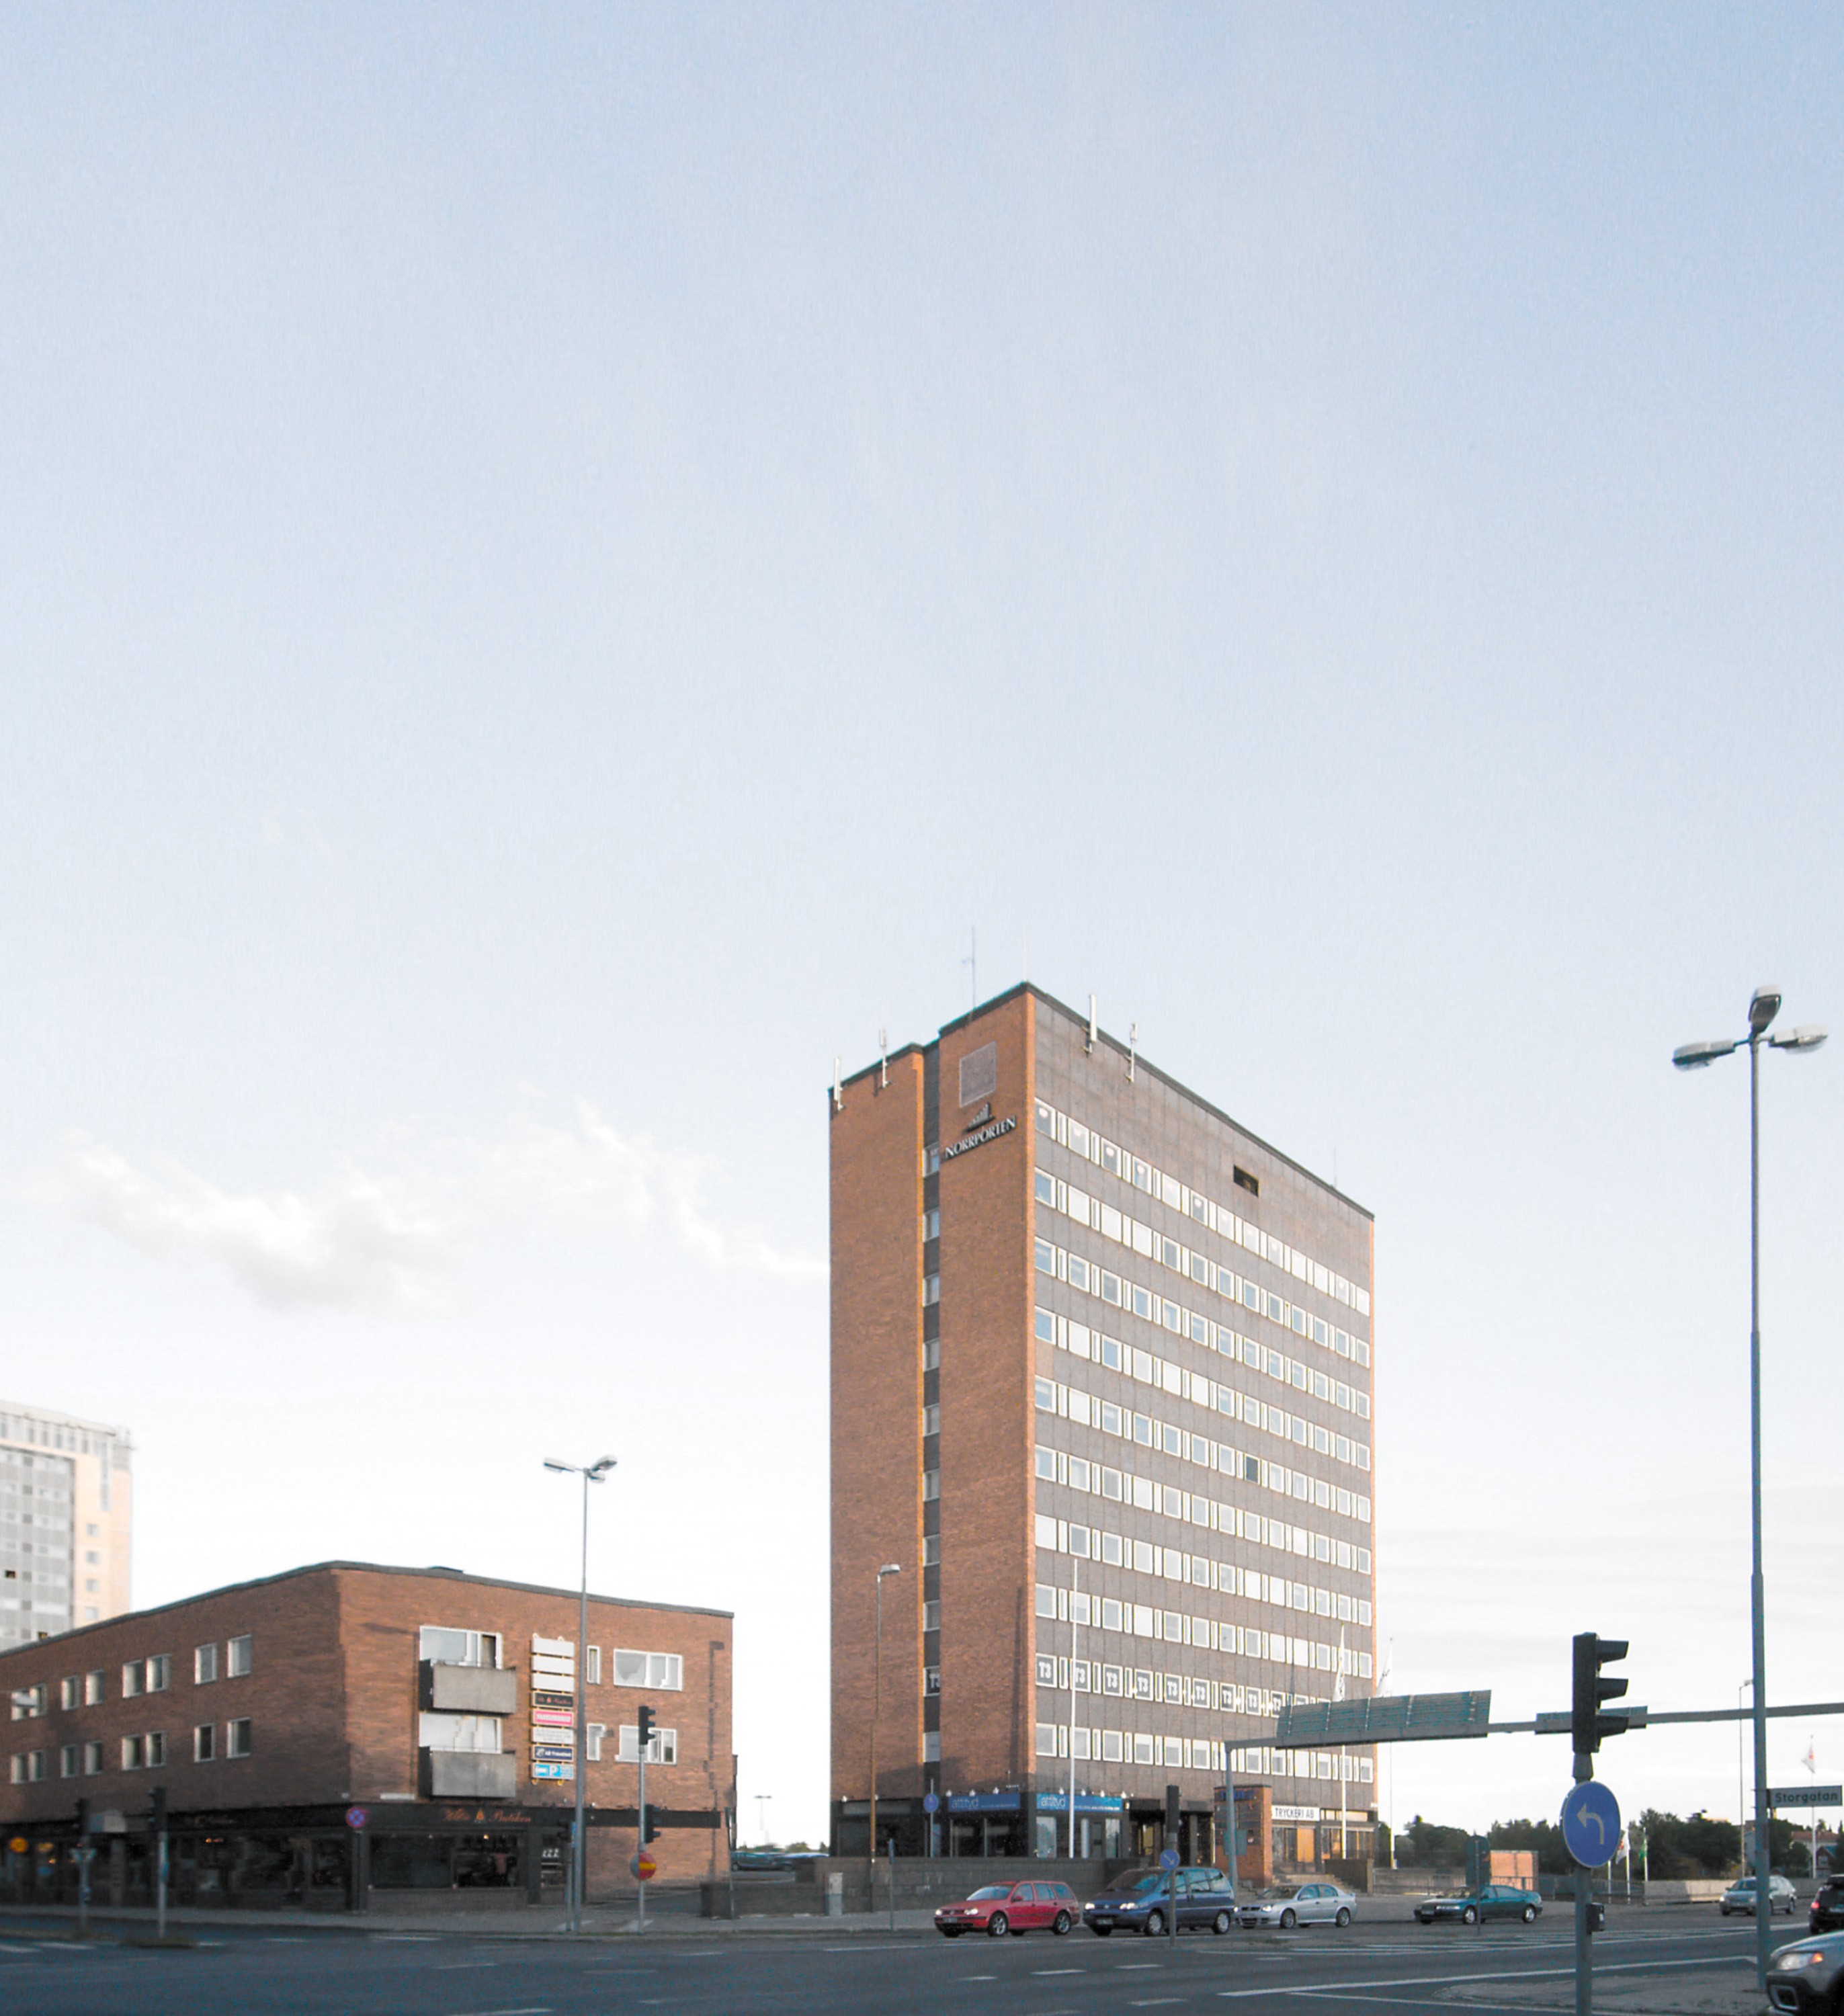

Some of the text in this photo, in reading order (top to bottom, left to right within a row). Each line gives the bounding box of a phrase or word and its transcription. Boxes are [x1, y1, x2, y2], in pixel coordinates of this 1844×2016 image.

[945, 1116, 1017, 1158] NORRPORTEN
[1038, 1662, 1051, 1679] T3
[1107, 1672, 1118, 1688] T3
[1138, 1677, 1148, 1692] T3
[1167, 1681, 1177, 1696] T3
[1196, 1685, 1205, 1700] T3
[1223, 1690, 1232, 1704] T3
[1249, 1693, 1257, 1708] T3
[1041, 1795, 1066, 1809] attityd
[1775, 1792, 1838, 1804] Storgatan
[1275, 1808, 1314, 1818] TRYCKERI AB
